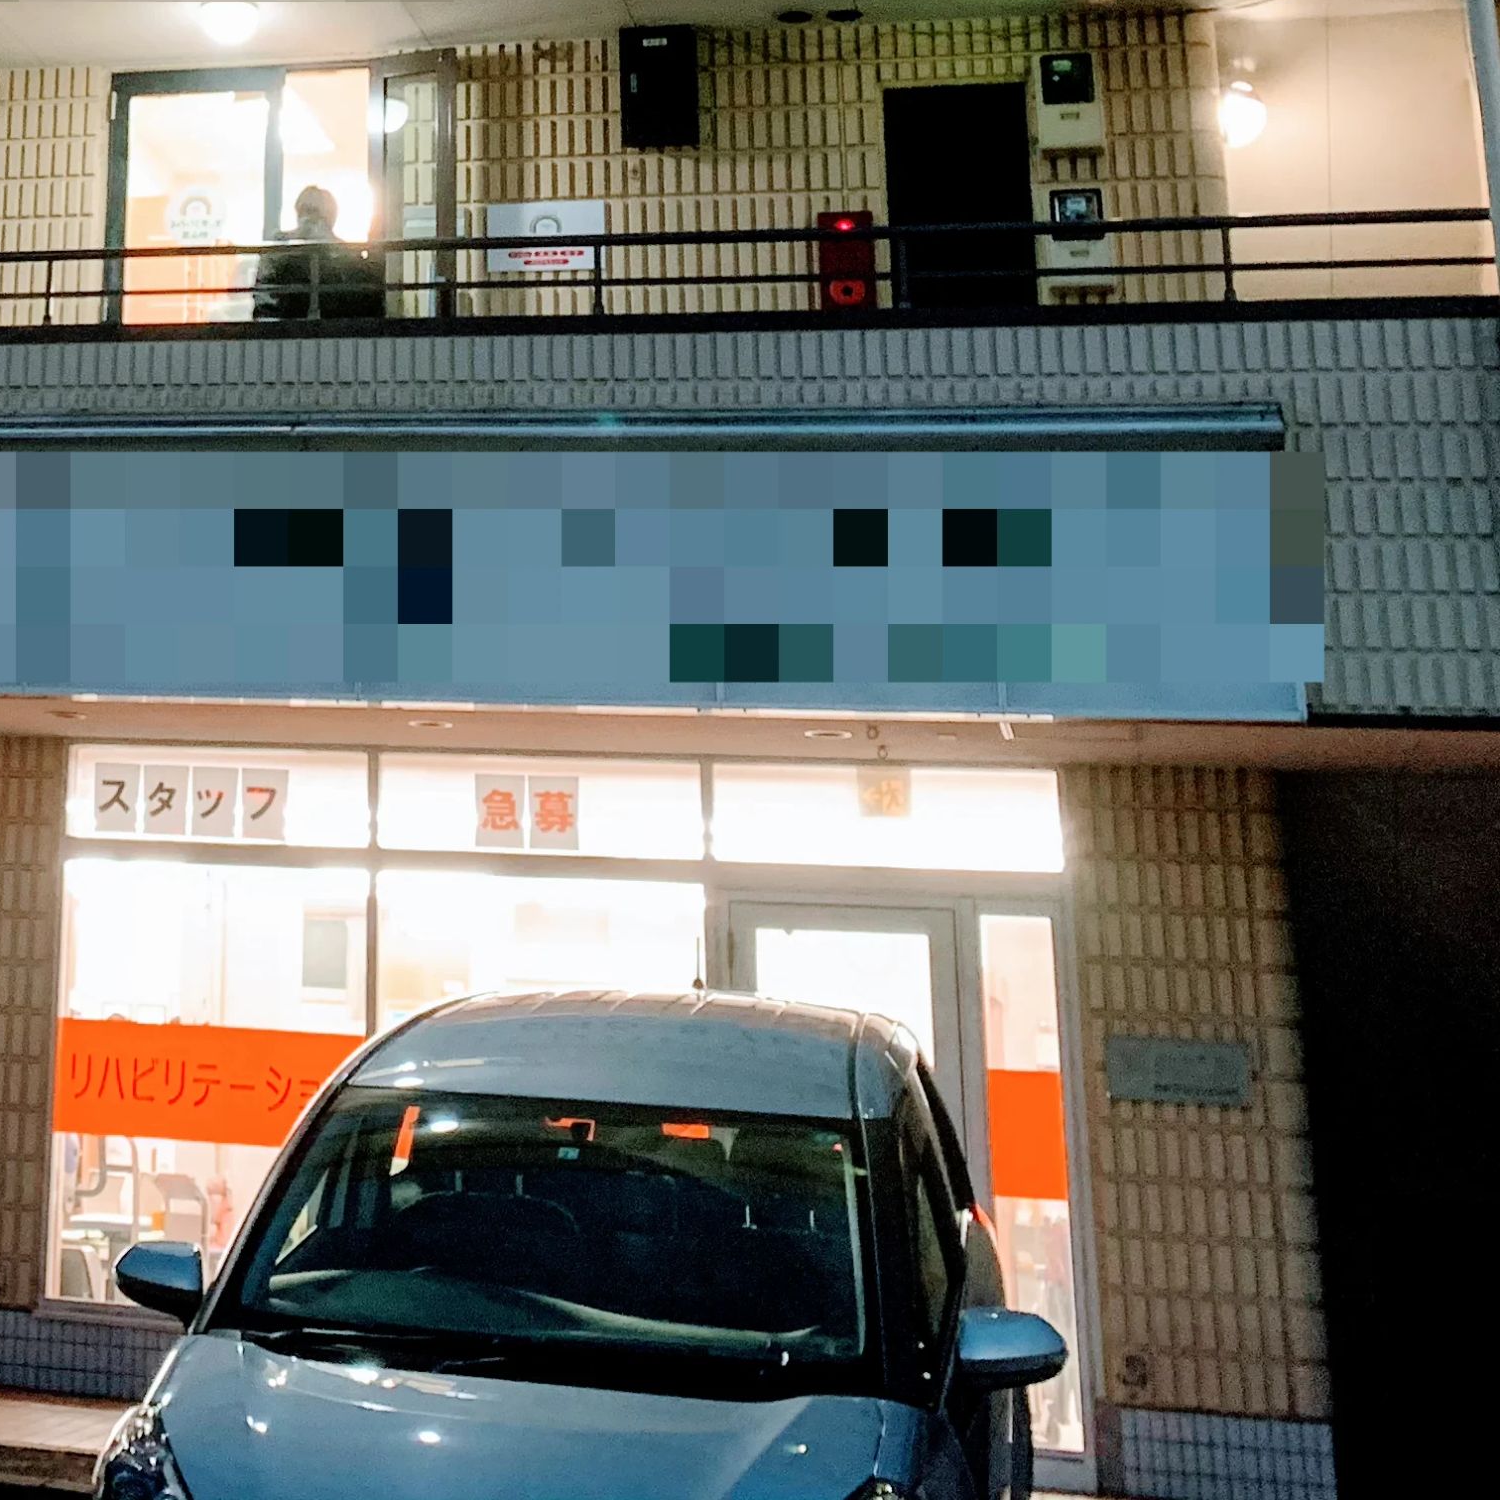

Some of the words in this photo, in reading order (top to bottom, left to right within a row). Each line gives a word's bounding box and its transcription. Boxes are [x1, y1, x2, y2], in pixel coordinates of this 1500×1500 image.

[99, 779, 277, 821] スタッフ
[482, 788, 574, 833] 急募
